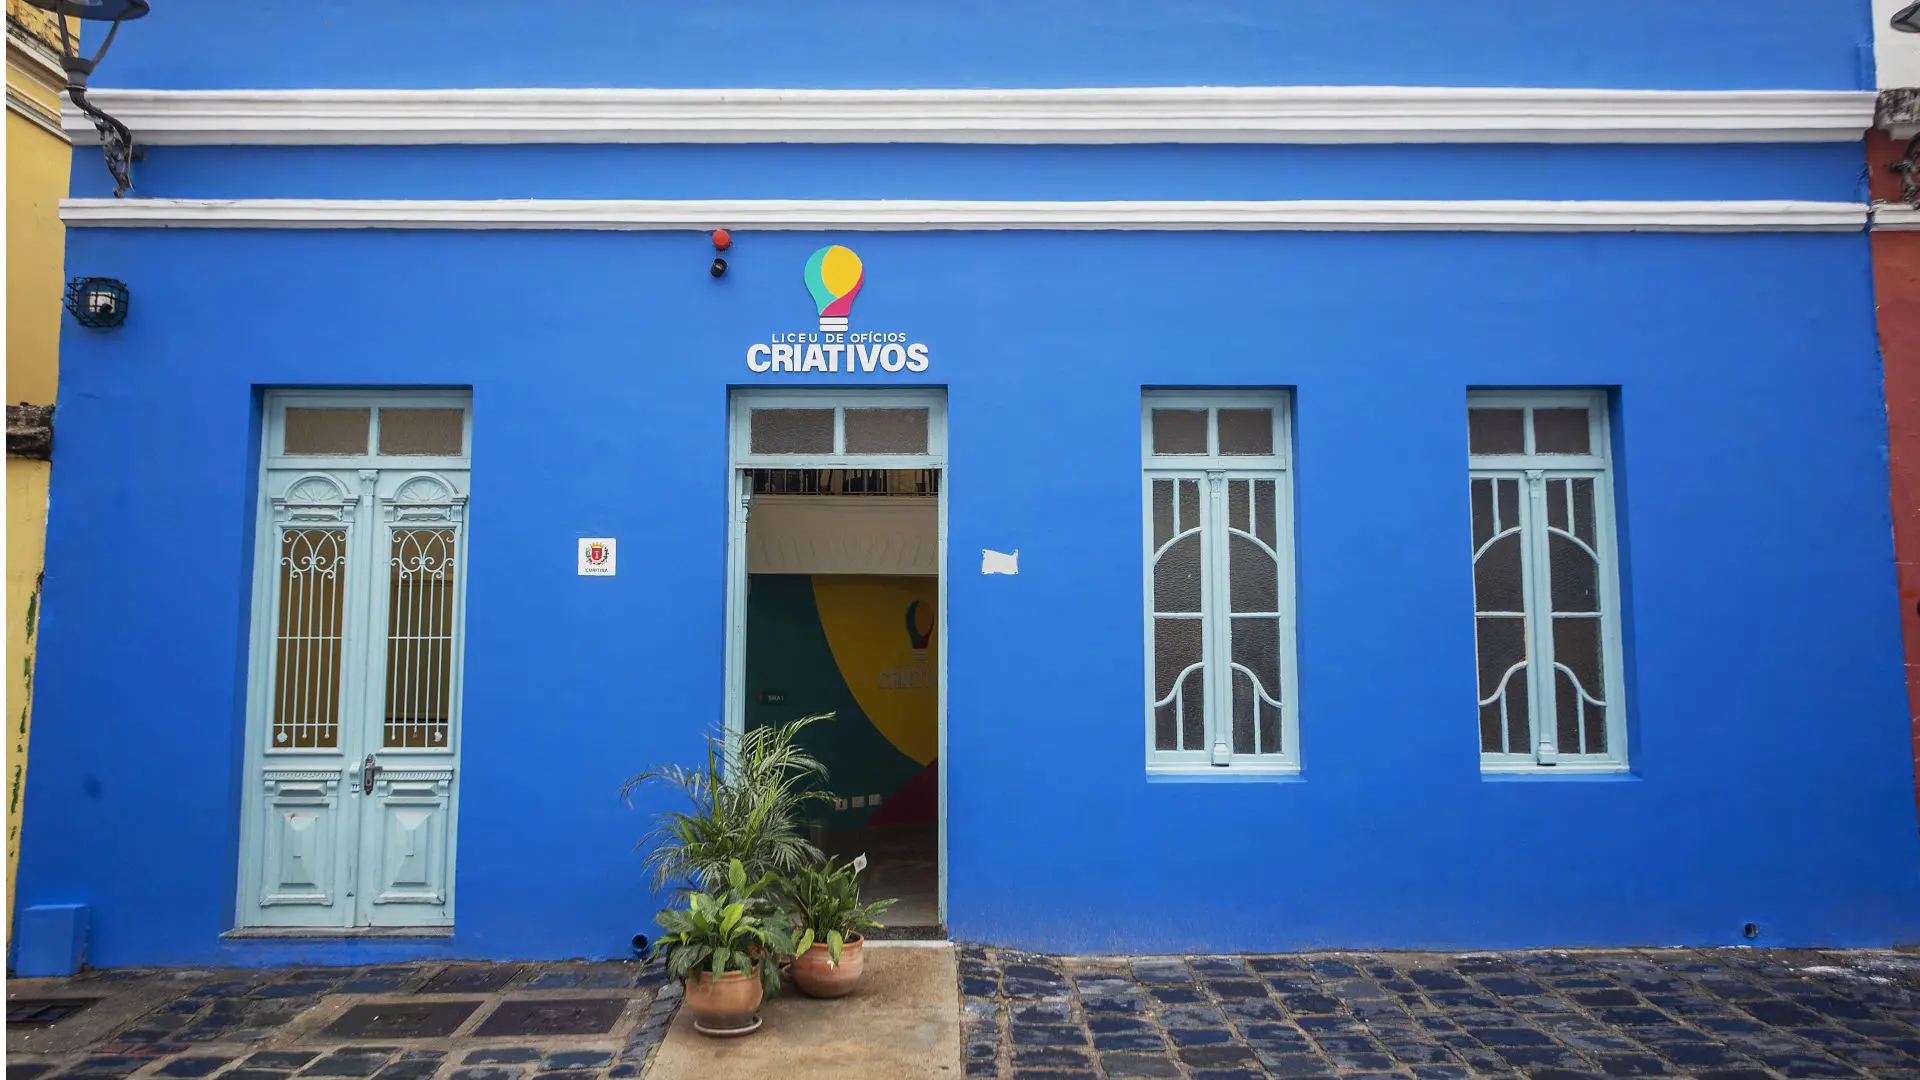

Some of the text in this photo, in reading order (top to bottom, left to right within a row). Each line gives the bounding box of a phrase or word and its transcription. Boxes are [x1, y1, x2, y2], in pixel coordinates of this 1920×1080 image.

[772, 331, 906, 343] LICEU DE OFÍCIOS
[746, 343, 929, 372] CRIATIVOS
